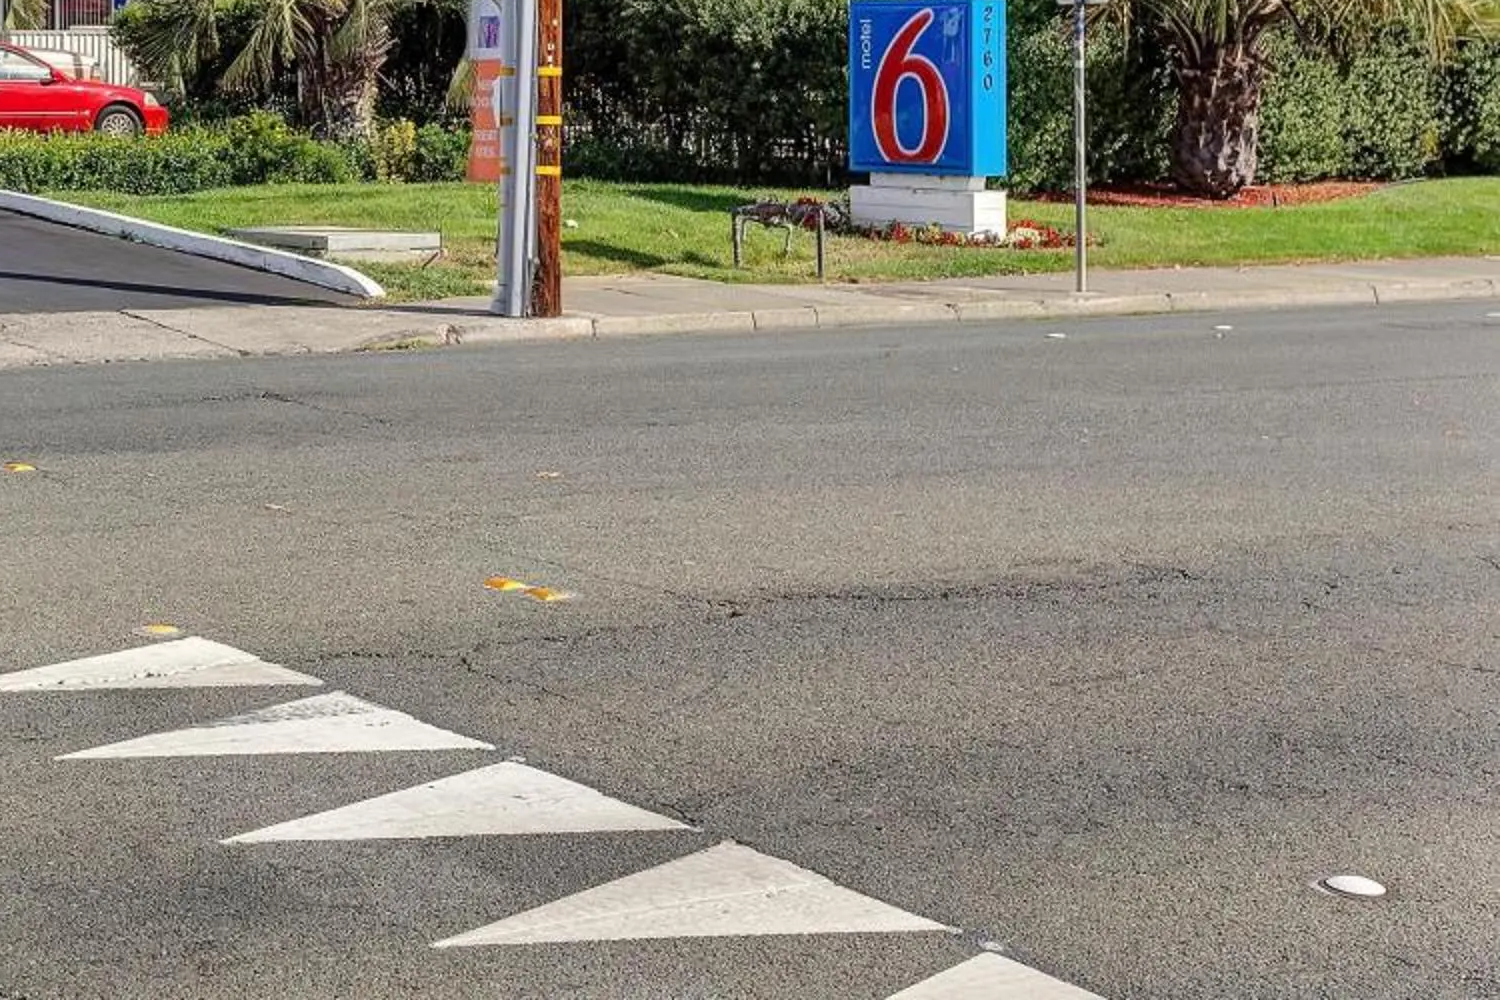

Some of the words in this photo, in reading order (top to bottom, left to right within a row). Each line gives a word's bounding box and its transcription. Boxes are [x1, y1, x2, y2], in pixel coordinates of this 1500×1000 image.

[860, 18, 872, 69] motel
[871, 7, 950, 164] 6
[983, 6, 994, 92] 2760
